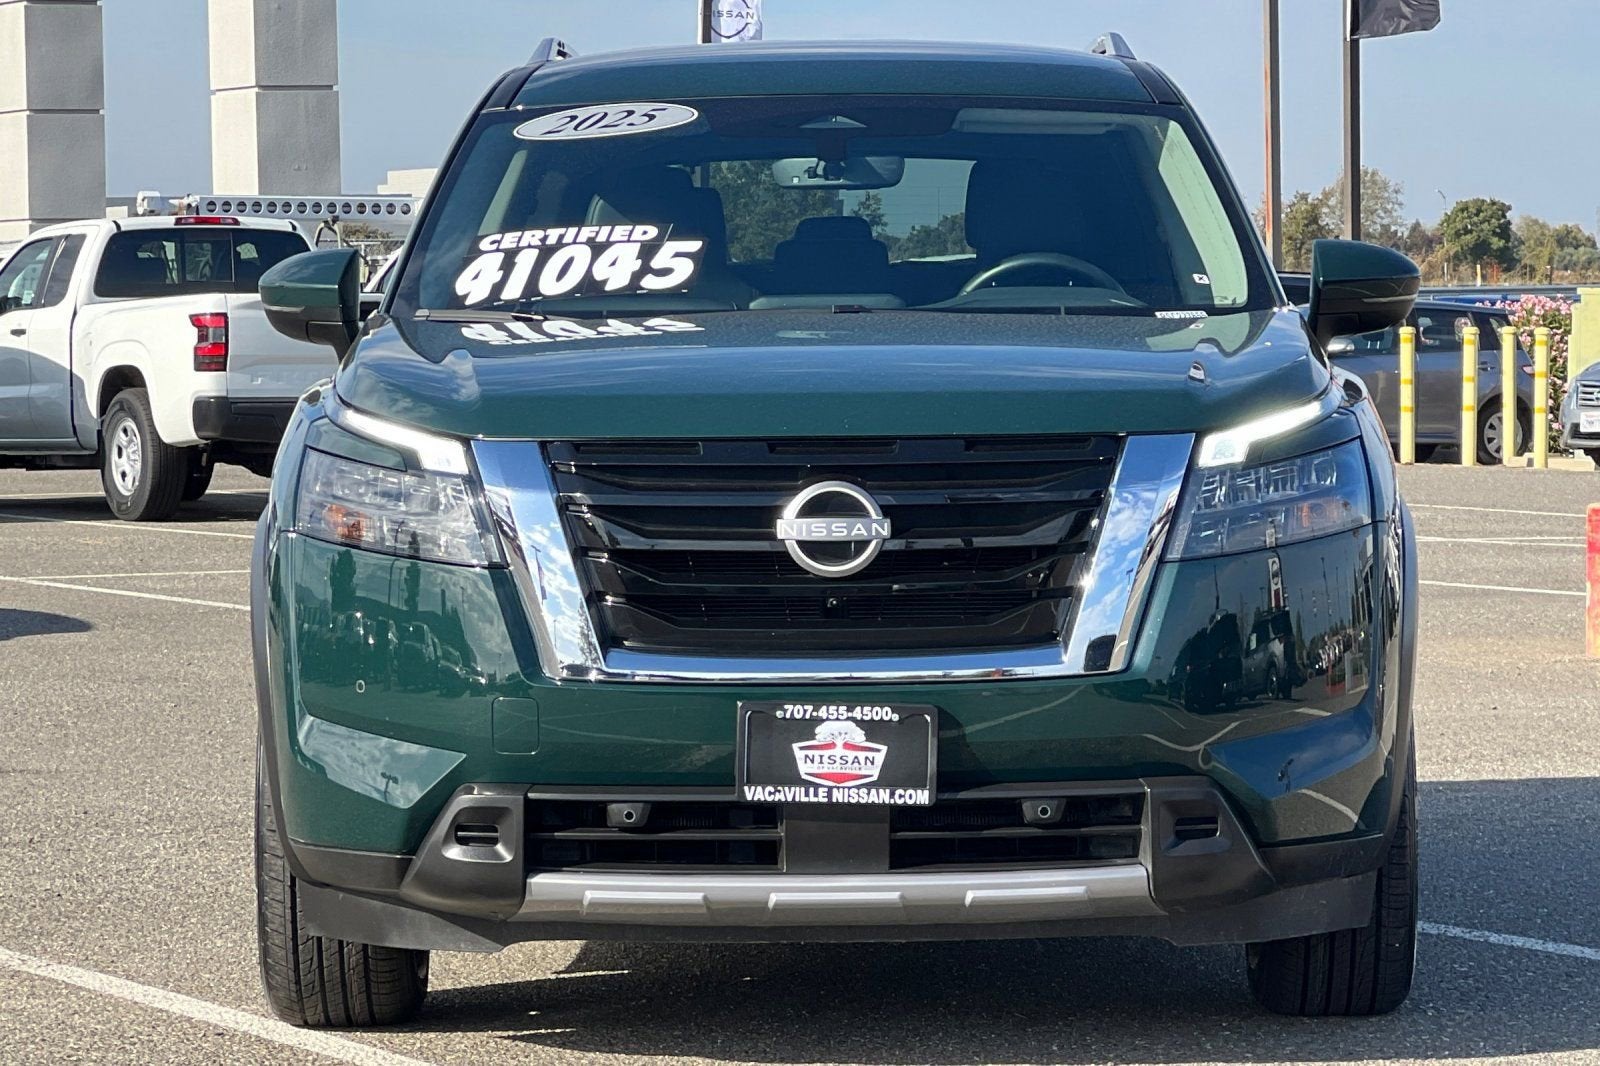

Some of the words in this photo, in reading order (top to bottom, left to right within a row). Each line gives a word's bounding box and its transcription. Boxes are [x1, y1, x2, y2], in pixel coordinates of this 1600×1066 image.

[712, 10, 754, 19] ISSAN
[541, 106, 668, 135] 2025
[479, 224, 659, 251] CERTIFIED
[455, 240, 702, 305] 41045
[781, 522, 888, 537] NISSAN
[784, 704, 892, 721] 707-455-4500
[804, 753, 875, 767] NISSAN
[744, 786, 828, 802] VACAVILLE
[832, 788, 930, 805] NISSAN.COM
